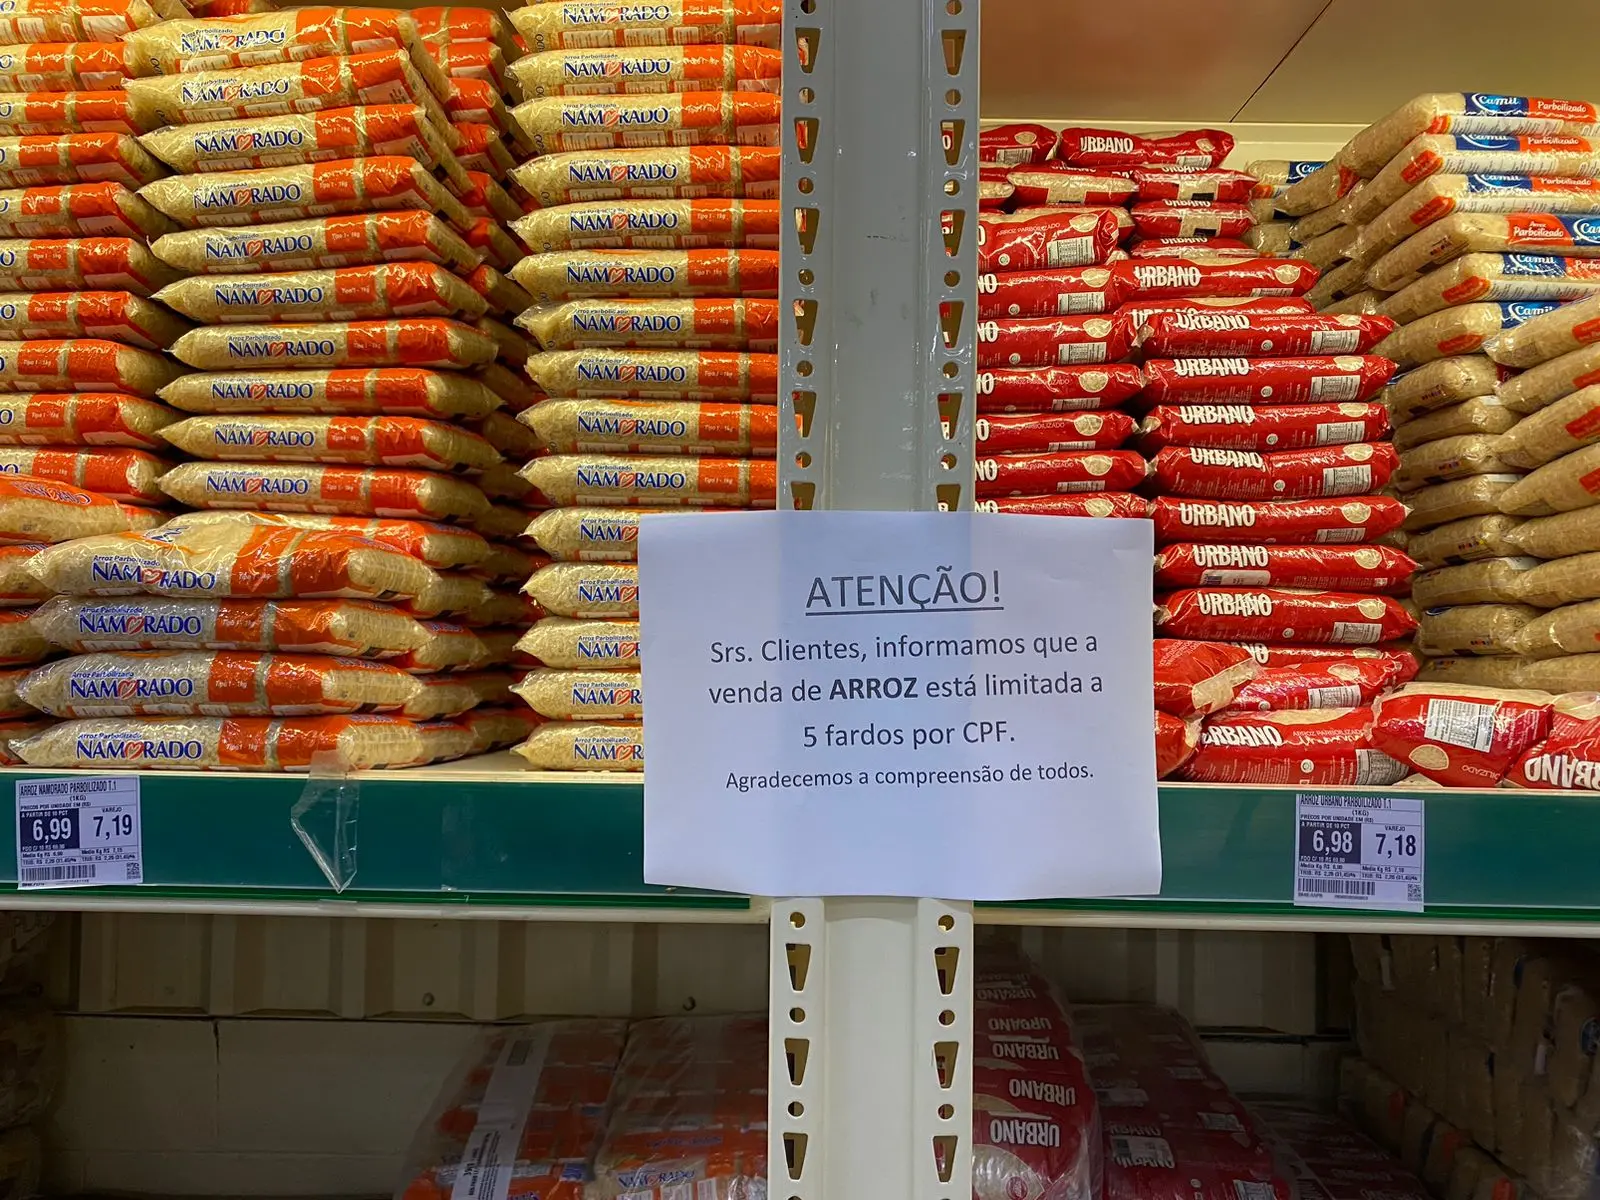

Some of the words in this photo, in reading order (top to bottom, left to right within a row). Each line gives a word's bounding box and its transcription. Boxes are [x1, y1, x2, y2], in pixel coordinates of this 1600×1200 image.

[563, 6, 670, 24] NAMORADO
[564, 60, 670, 77] NAMORADO
[1538, 101, 1586, 113] Parboilizado
[563, 108, 668, 127] NAMORADO
[195, 129, 302, 153] NAMORADO
[1080, 136, 1134, 153] URBANO
[570, 164, 677, 182] NAMORADO
[194, 184, 301, 208] NAMORADO
[571, 213, 678, 231] NAMORADO
[1513, 227, 1564, 237] Parboilizado
[206, 235, 312, 259] NAMORADO
[568, 267, 674, 283] NAMORADO
[1134, 266, 1201, 287] URBANO
[216, 288, 323, 305] NAMORADO
[574, 316, 681, 332] NAMORADO
[229, 340, 335, 358] NAMORADO
[578, 366, 685, 382] NAMORADO
[1174, 358, 1250, 376] URBANO
[212, 383, 313, 400] NAMORADO
[1180, 406, 1255, 425] URBANO
[578, 416, 685, 436] NAMORADO
[215, 429, 314, 446] NAMORADO
[1190, 448, 1264, 469] URBANO
[207, 476, 308, 494] NAMORADO
[577, 470, 685, 489] NAMORADO
[1180, 503, 1255, 527] URBANO
[1193, 545, 1269, 567] URBANO
[92, 563, 216, 590] NAMORADO
[805, 565, 1002, 609] ATENÇÃO!
[1196, 592, 1272, 617] URBANO
[80, 616, 201, 635] NAMORADO
[711, 642, 752, 663] Srs.
[762, 639, 866, 662] Clientes,
[876, 635, 1025, 657] informamos
[1034, 637, 1077, 658] que
[1086, 636, 1097, 651] a
[71, 678, 193, 700] NAMORADO
[709, 681, 782, 703] venda
[792, 679, 821, 701] de
[829, 677, 918, 700] ARROZ
[926, 674, 976, 697] está
[986, 672, 1082, 695] limitada
[1091, 677, 1102, 692] a
[804, 727, 817, 747] 5
[825, 723, 903, 746] fardos
[914, 728, 955, 750] por
[963, 721, 1014, 743] CPF.
[77, 740, 202, 760] NAMORADO
[726, 771, 852, 792] Agradecemos
[859, 772, 868, 784] a
[876, 766, 1003, 788] compreensão
[1010, 764, 1031, 781] de
[1038, 762, 1093, 779] todos.
[21, 786, 37, 796] ARROZ
[39, 783, 68, 794] NAMORADO
[70, 781, 107, 793] PARBOILIZADO
[1321, 796, 1342, 807] URBANO
[1344, 797, 1382, 808] PARBOILIZADO
[1383, 798, 1392, 809] T.1
[33, 818, 72, 843] 6,99
[93, 814, 132, 840] 7,19
[1313, 830, 1353, 856] 6,98
[1375, 833, 1416, 859] 7,18
[988, 1016, 1052, 1031] URBANO
[993, 1041, 1060, 1061] URBANO
[1009, 1078, 1076, 1106] URBANO
[991, 1119, 1060, 1148] URBANO
